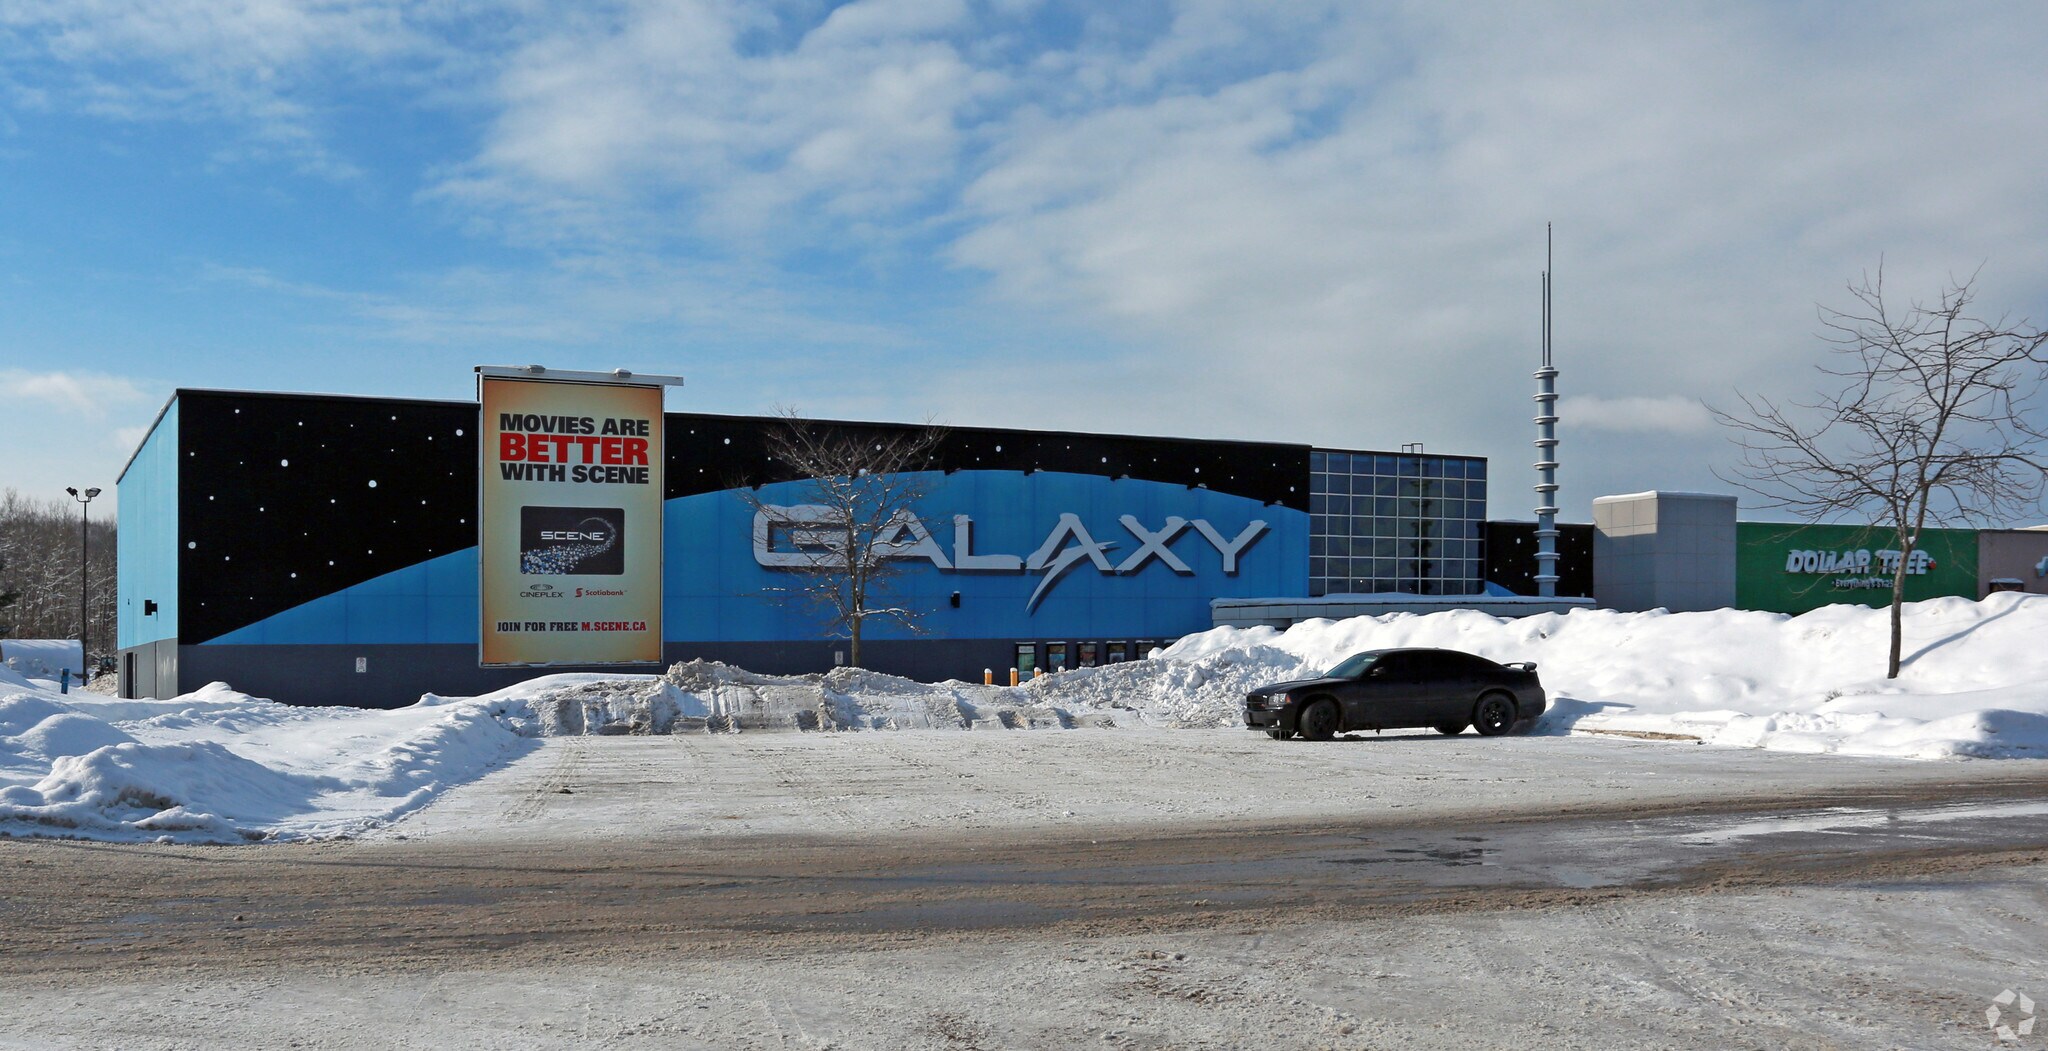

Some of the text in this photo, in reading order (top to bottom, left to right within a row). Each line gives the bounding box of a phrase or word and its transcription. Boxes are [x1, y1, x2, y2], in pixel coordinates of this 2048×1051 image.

[500, 413, 649, 436] MOVIES ARE
[500, 432, 649, 465] BETTER
[500, 463, 649, 484] WITH SCENE
[541, 531, 605, 541] SCENE
[753, 504, 1271, 613] GALAXY
[1786, 549, 1871, 574] DOLLAR
[497, 621, 647, 632] JOIN FOR FREE M.SCENE.CA
